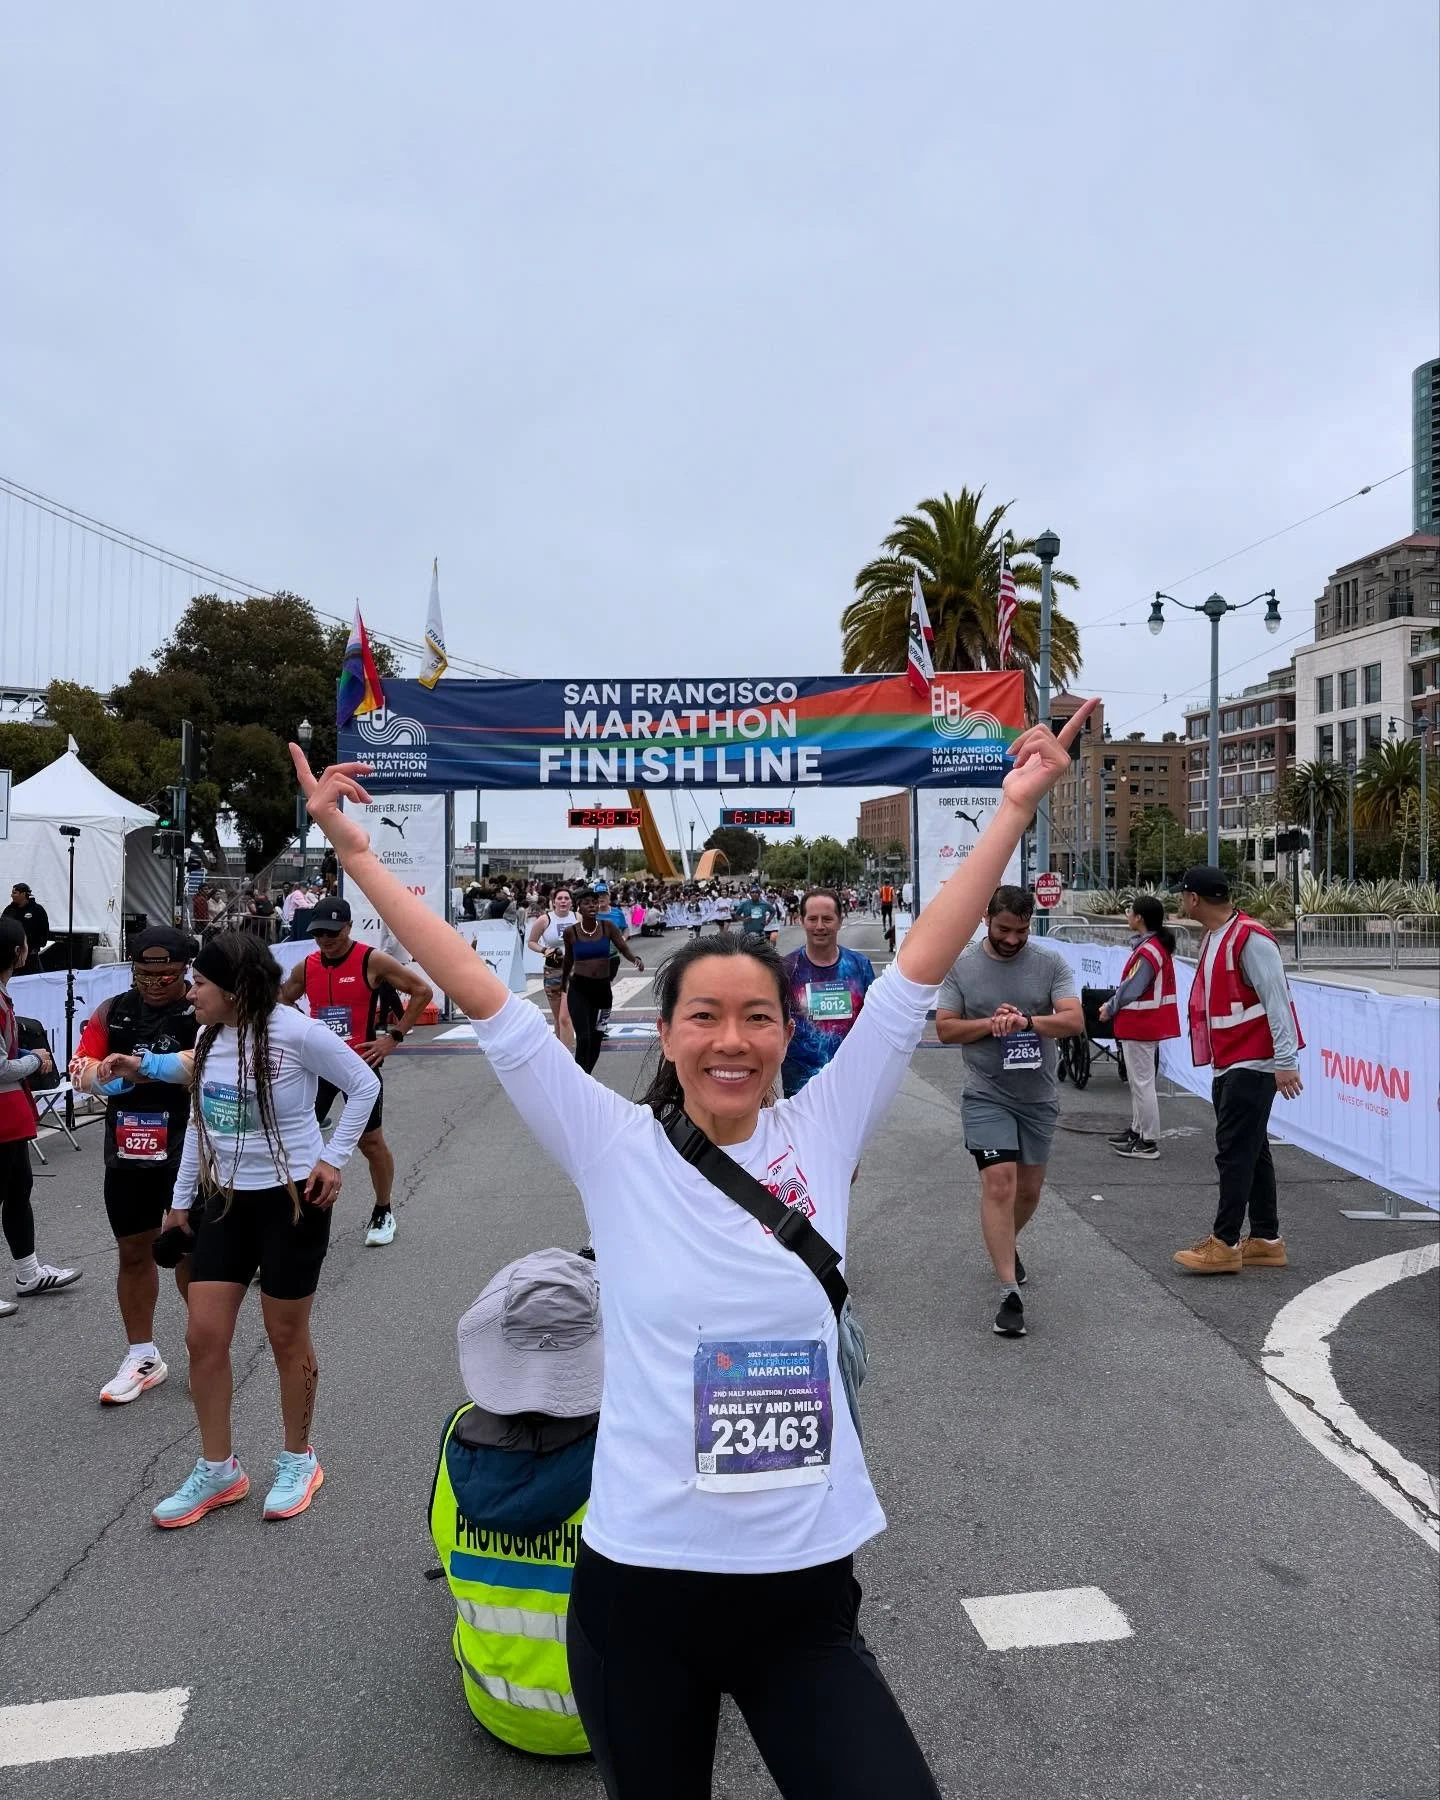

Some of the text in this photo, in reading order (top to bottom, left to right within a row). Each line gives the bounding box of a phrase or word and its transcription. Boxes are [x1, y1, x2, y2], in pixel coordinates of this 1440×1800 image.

[563, 682, 798, 705] SAN FRANCISCO
[564, 708, 797, 739] MARATHON
[356, 752, 428, 760] SAN FRANCISCO
[932, 745, 1003, 755] SAN FRANCISCO
[357, 760, 427, 770] ARATHON
[539, 746, 822, 783] FINISH LINE
[932, 753, 1003, 765] MARATHON
[938, 796, 999, 806] FOREVER. FASTER.
[365, 803, 424, 813] FOREVER. FASTER.
[382, 850, 409, 858] CHINA
[379, 857, 414, 865] AIRLINES
[820, 1000, 846, 1011] 8012
[329, 1022, 348, 1034] 251
[1007, 1046, 1041, 1059] 22634
[1320, 1048, 1410, 1103] TAIWAN
[125, 1137, 158, 1150] 8275
[747, 1358, 810, 1367] SAN FRANCISCO
[747, 1365, 810, 1377] MARATHON
[746, 1389, 782, 1397] MARATHON
[708, 1400, 823, 1416] MARLEY AND MILO
[711, 1415, 819, 1455] 23463
[456, 1505, 582, 1563] PHOTOGRAPH
